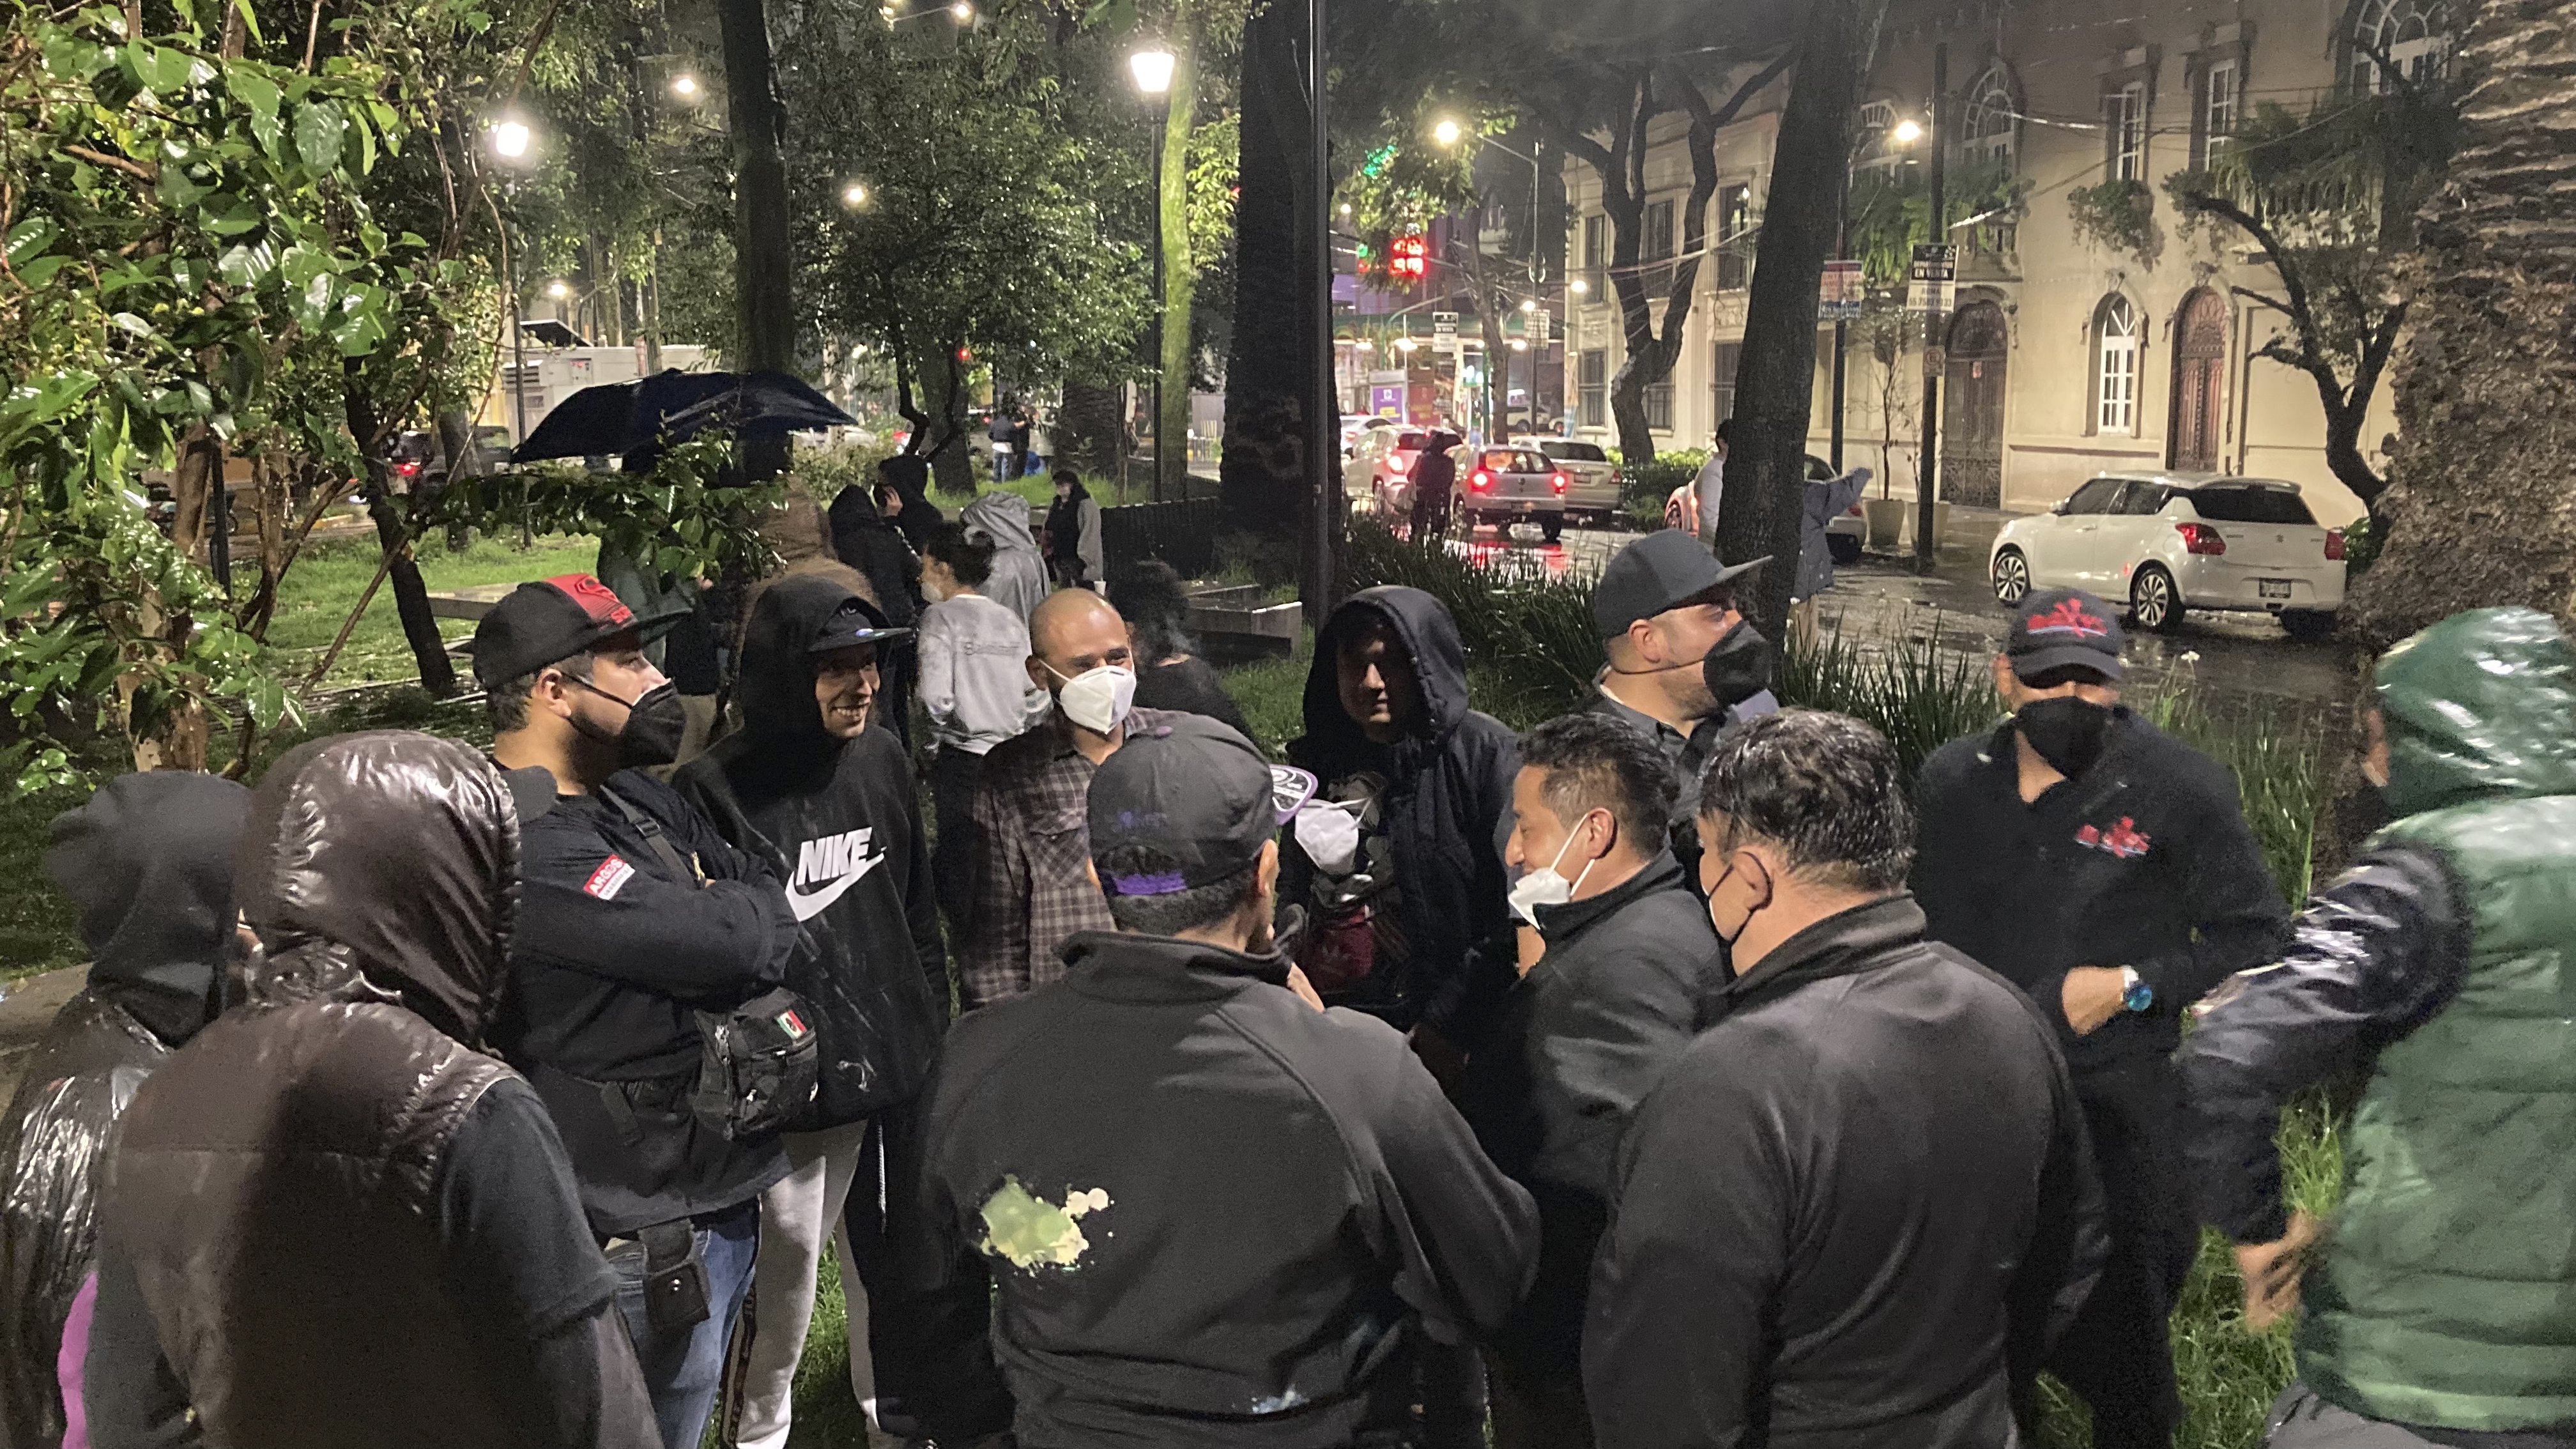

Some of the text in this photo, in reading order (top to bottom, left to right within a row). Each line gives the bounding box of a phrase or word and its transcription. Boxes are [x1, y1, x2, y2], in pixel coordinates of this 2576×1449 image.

[1915, 268, 1924, 278] EN
[796, 827, 873, 885] NIKE
[589, 859, 624, 894] ARGOS
